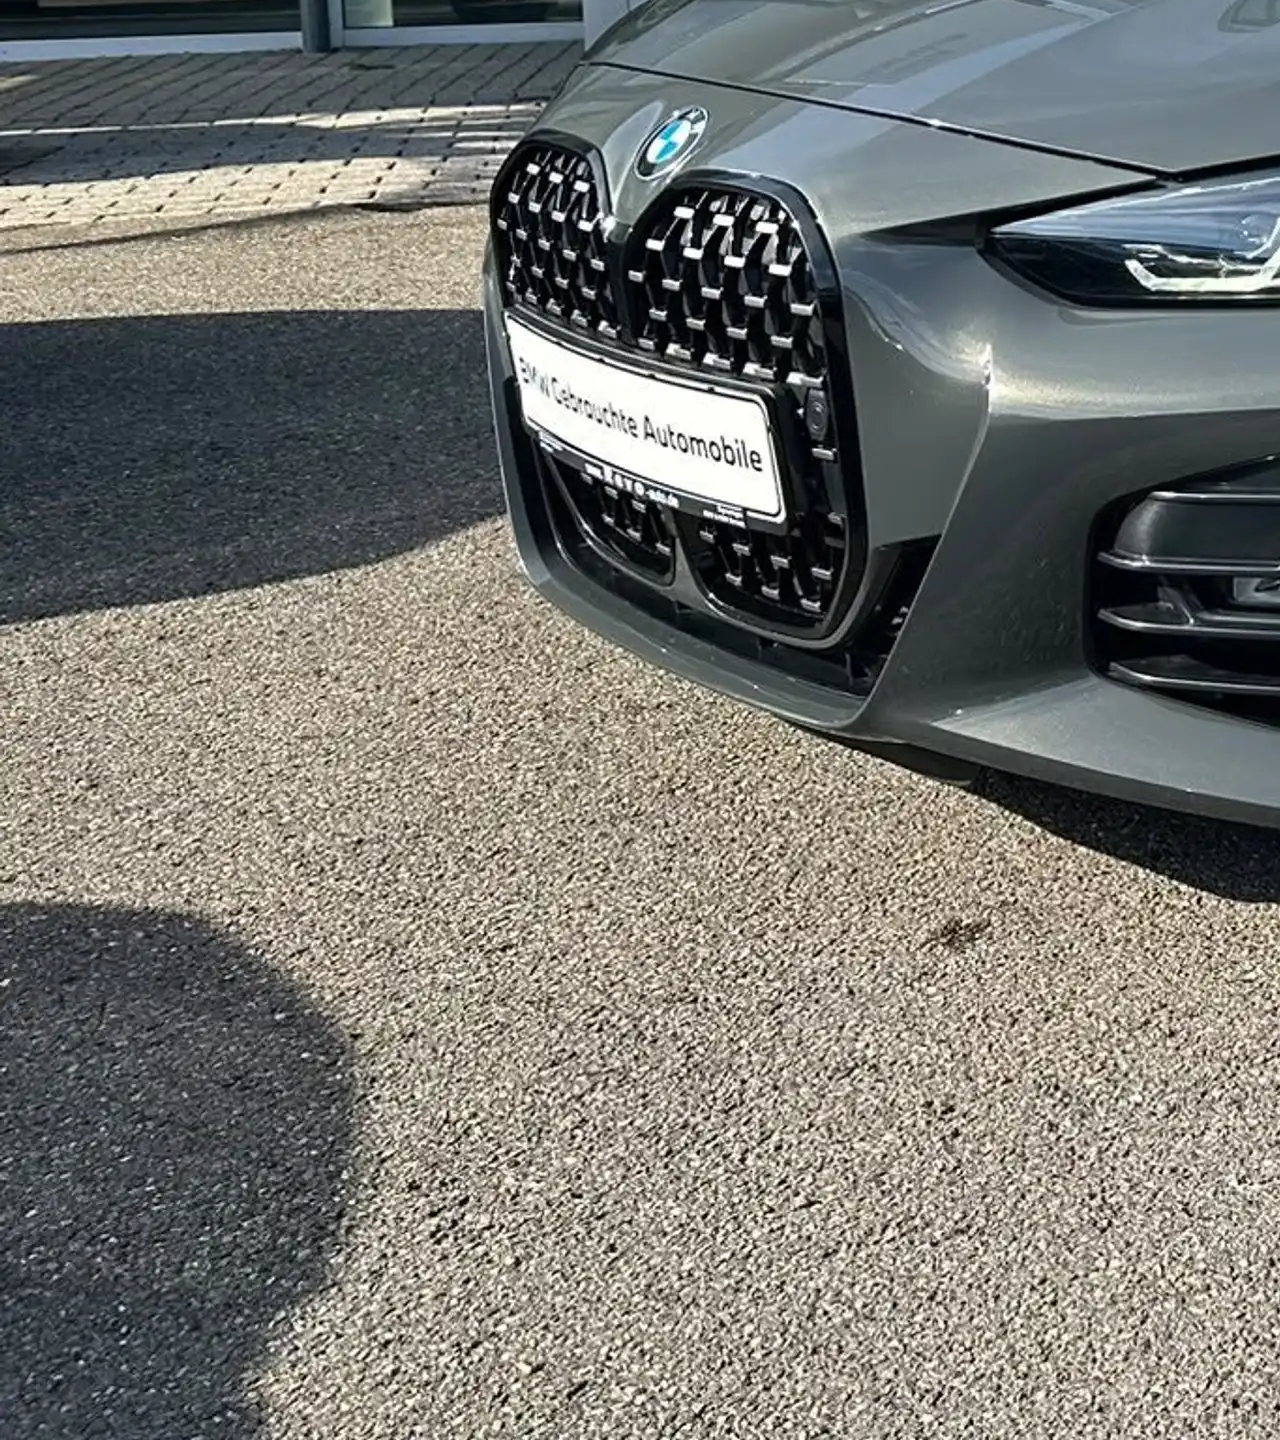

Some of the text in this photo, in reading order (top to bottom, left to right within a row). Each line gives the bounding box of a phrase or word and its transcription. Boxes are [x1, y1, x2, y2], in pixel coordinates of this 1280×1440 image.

[519, 356, 764, 473] BMW Gebrauchte Automobile
